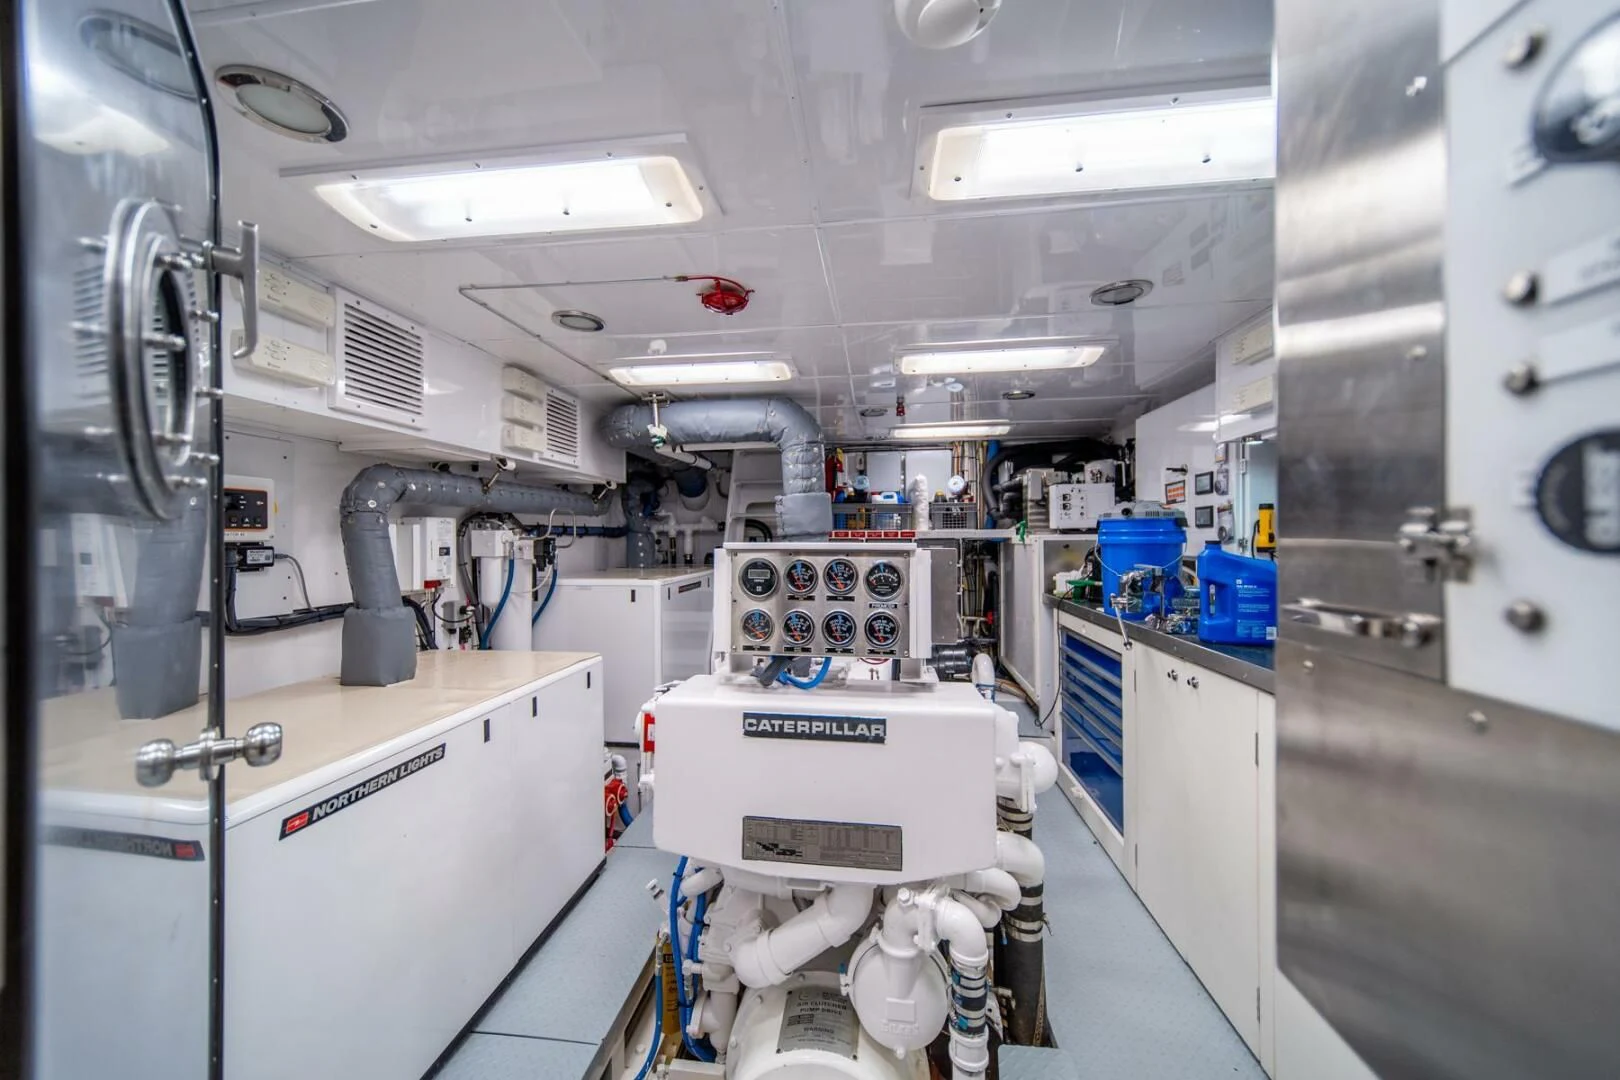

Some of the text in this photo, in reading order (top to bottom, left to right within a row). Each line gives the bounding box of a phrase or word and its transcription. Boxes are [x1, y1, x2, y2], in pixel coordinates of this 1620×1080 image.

[744, 718, 885, 737] CATERPILLAR
[312, 748, 443, 820] NORTHERN LIGHTS
